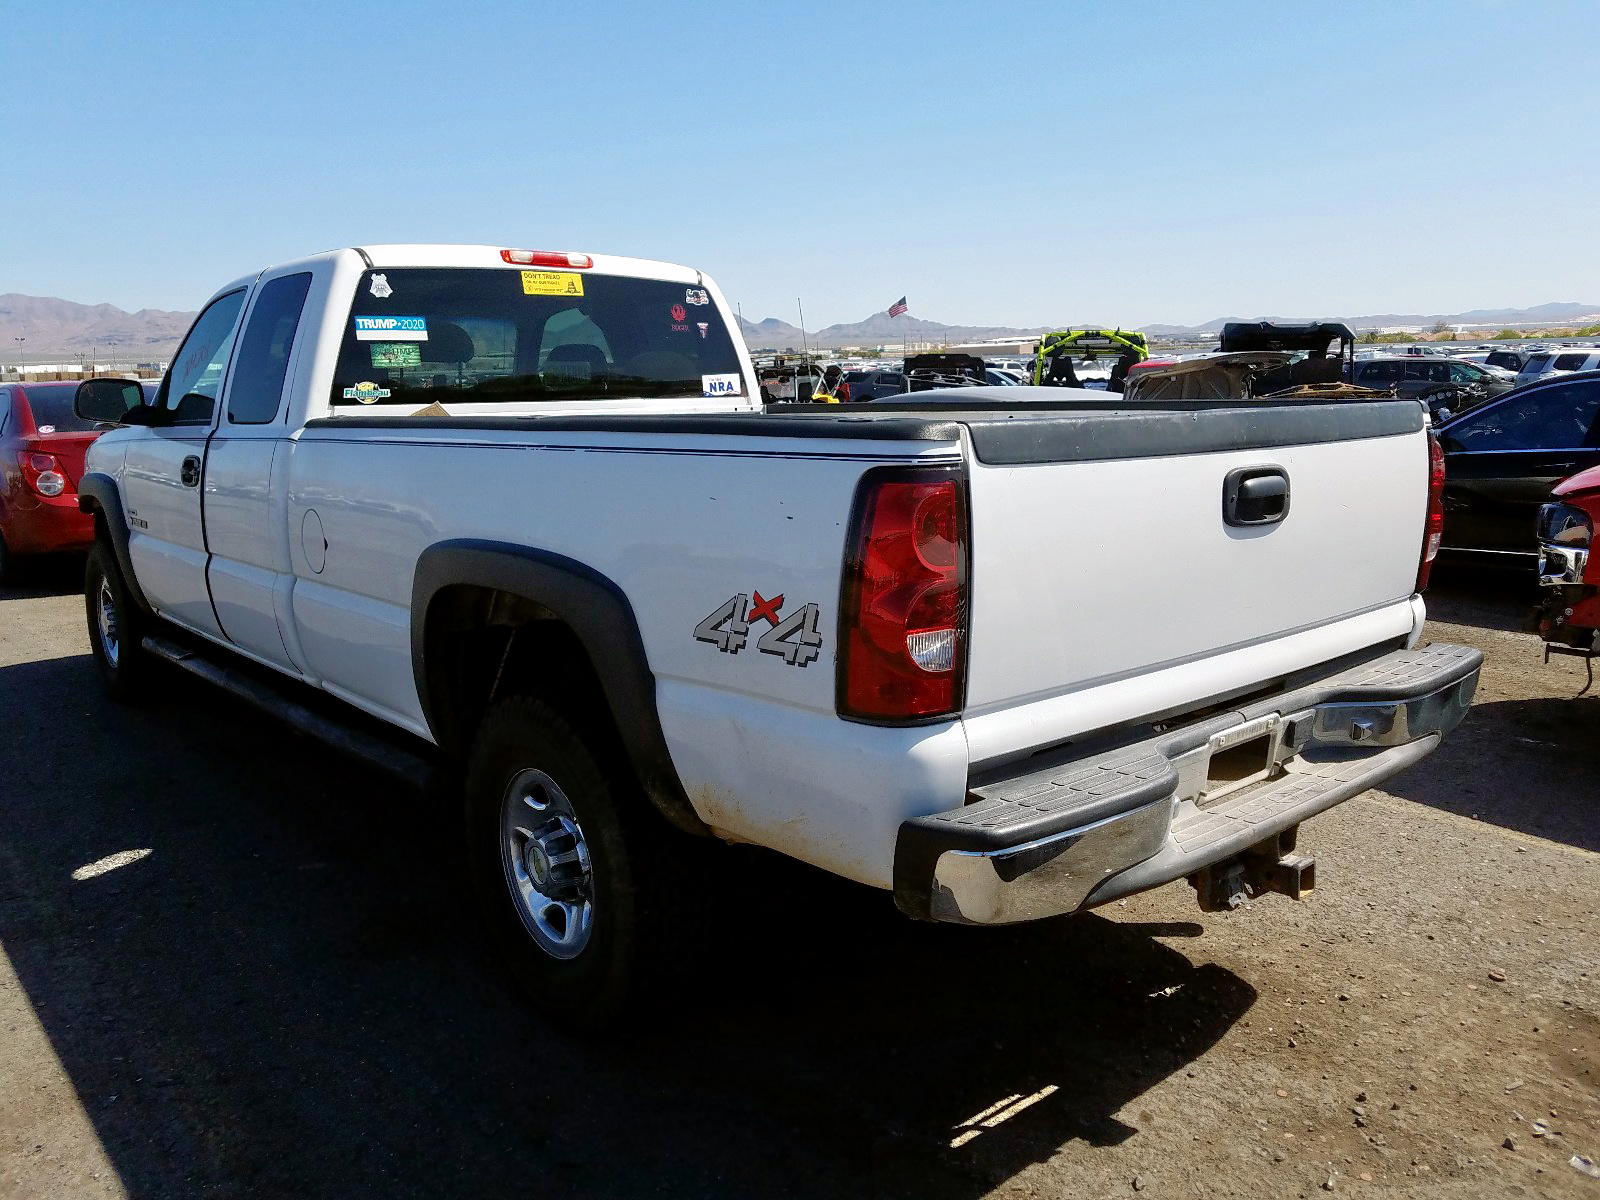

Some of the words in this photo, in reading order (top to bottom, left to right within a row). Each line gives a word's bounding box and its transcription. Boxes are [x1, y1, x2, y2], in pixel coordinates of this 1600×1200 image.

[523, 272, 541, 280] DON'T
[356, 318, 398, 329] TRUMP
[401, 319, 425, 329] 2020
[709, 380, 734, 392] NRA
[344, 388, 389, 398] Flambeau
